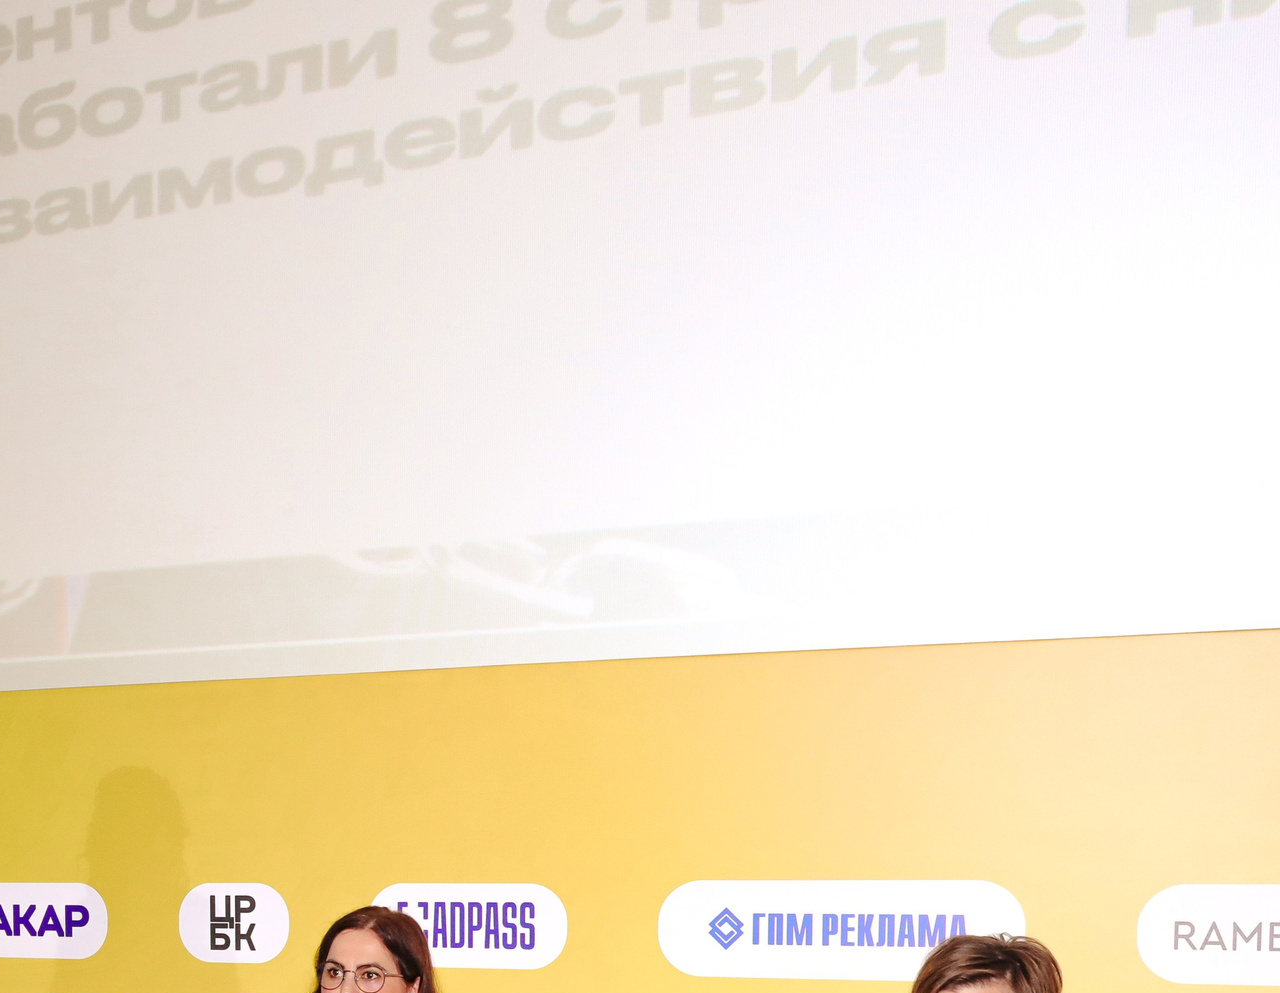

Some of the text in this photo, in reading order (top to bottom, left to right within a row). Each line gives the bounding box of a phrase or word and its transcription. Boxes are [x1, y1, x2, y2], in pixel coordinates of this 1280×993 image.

[428, 0, 515, 65] 8
[989, 0, 1088, 60] с
[209, 895, 257, 929] ЦР
[209, 923, 257, 951] БК
[752, 913, 967, 948] ГПМ РЕКЛАМА
